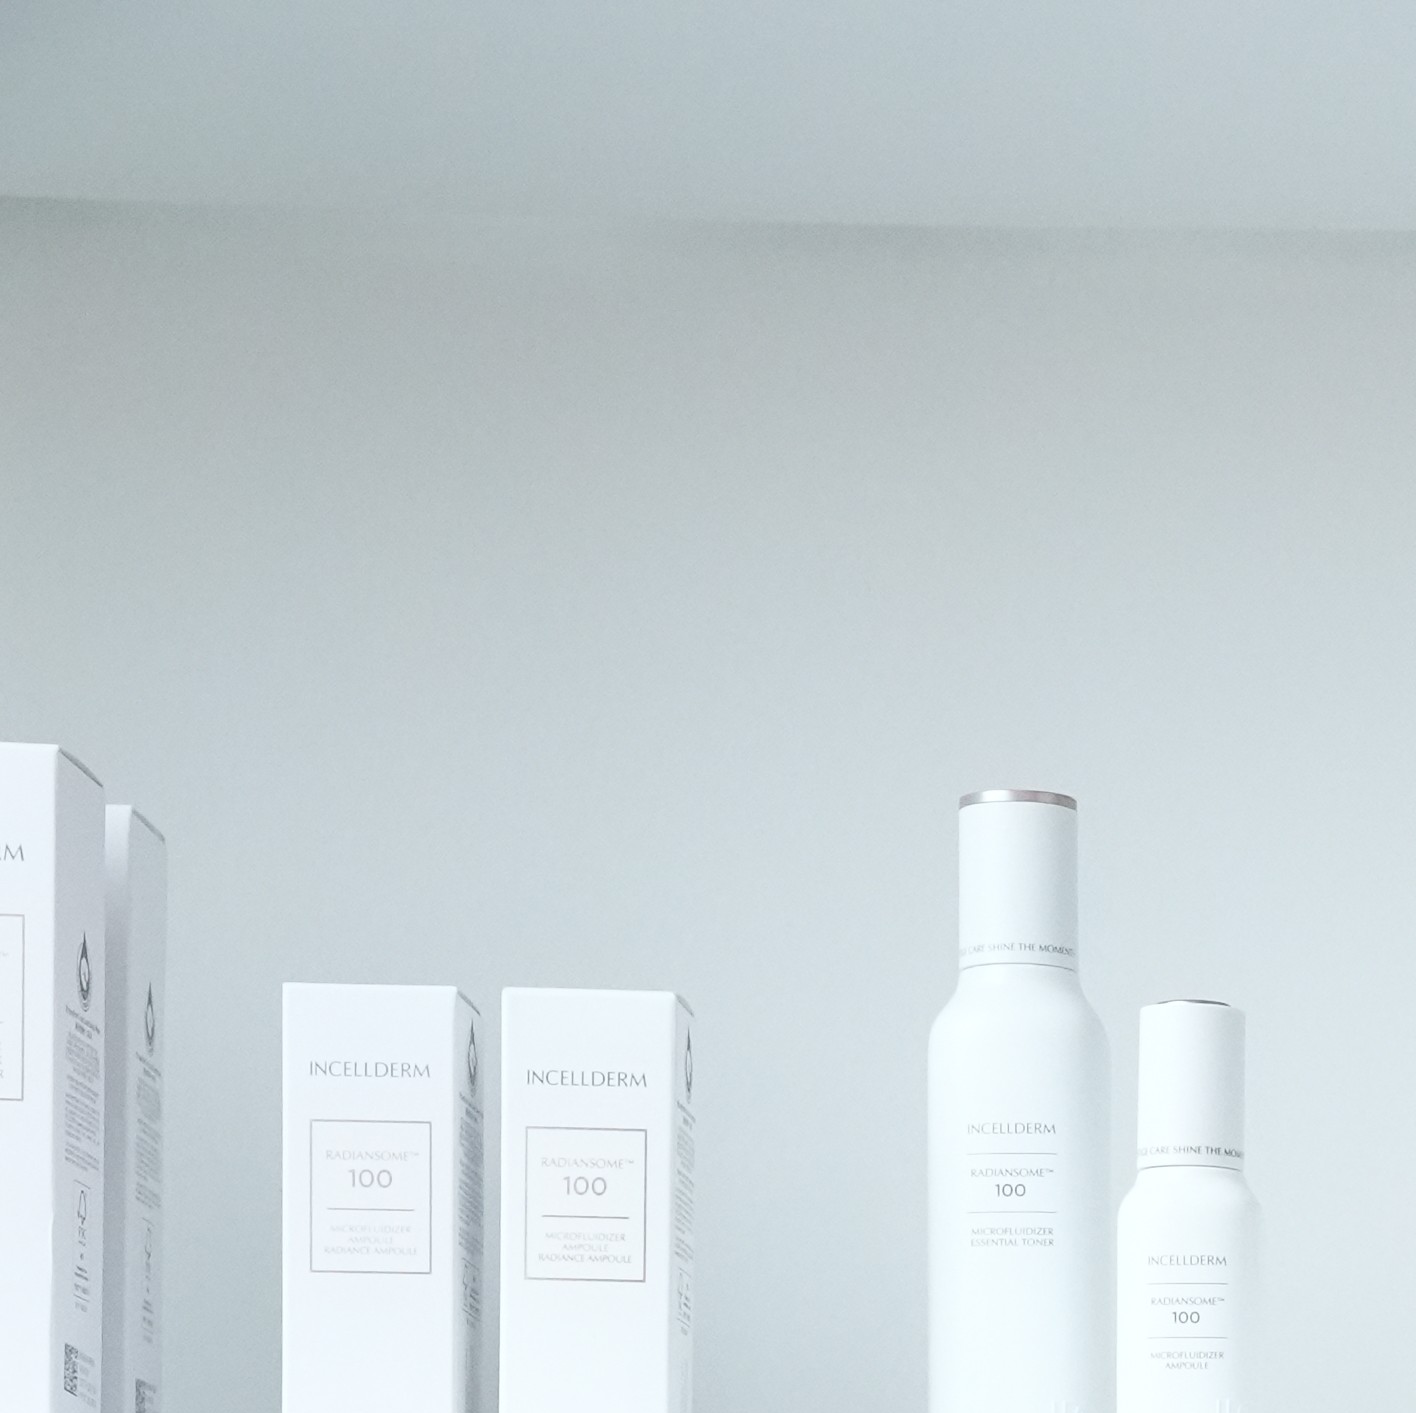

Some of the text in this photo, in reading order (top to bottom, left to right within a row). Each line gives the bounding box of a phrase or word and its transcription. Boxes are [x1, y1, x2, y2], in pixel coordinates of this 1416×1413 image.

[987, 942, 1015, 951] SHINE
[1018, 942, 1036, 951] THE
[310, 1060, 431, 1078] INCELLDERM
[526, 1069, 647, 1088] INCELLDERM
[967, 1122, 1056, 1135] INCELLDERM
[1173, 1146, 1201, 1154] SHINE
[1203, 1146, 1221, 1155] THE
[347, 1169, 393, 1188] 100
[563, 1176, 608, 1197] 100
[994, 1184, 1027, 1197] 100
[561, 1243, 608, 1252] AMPOULE
[970, 1238, 1054, 1247] ESSENTIAL TONER
[538, 1254, 632, 1264] RADIANCE AMPOULE
[1147, 1255, 1228, 1266] INCELLDERM
[1171, 1311, 1201, 1324] 100
[1165, 1361, 1209, 1370] AMPOULE
